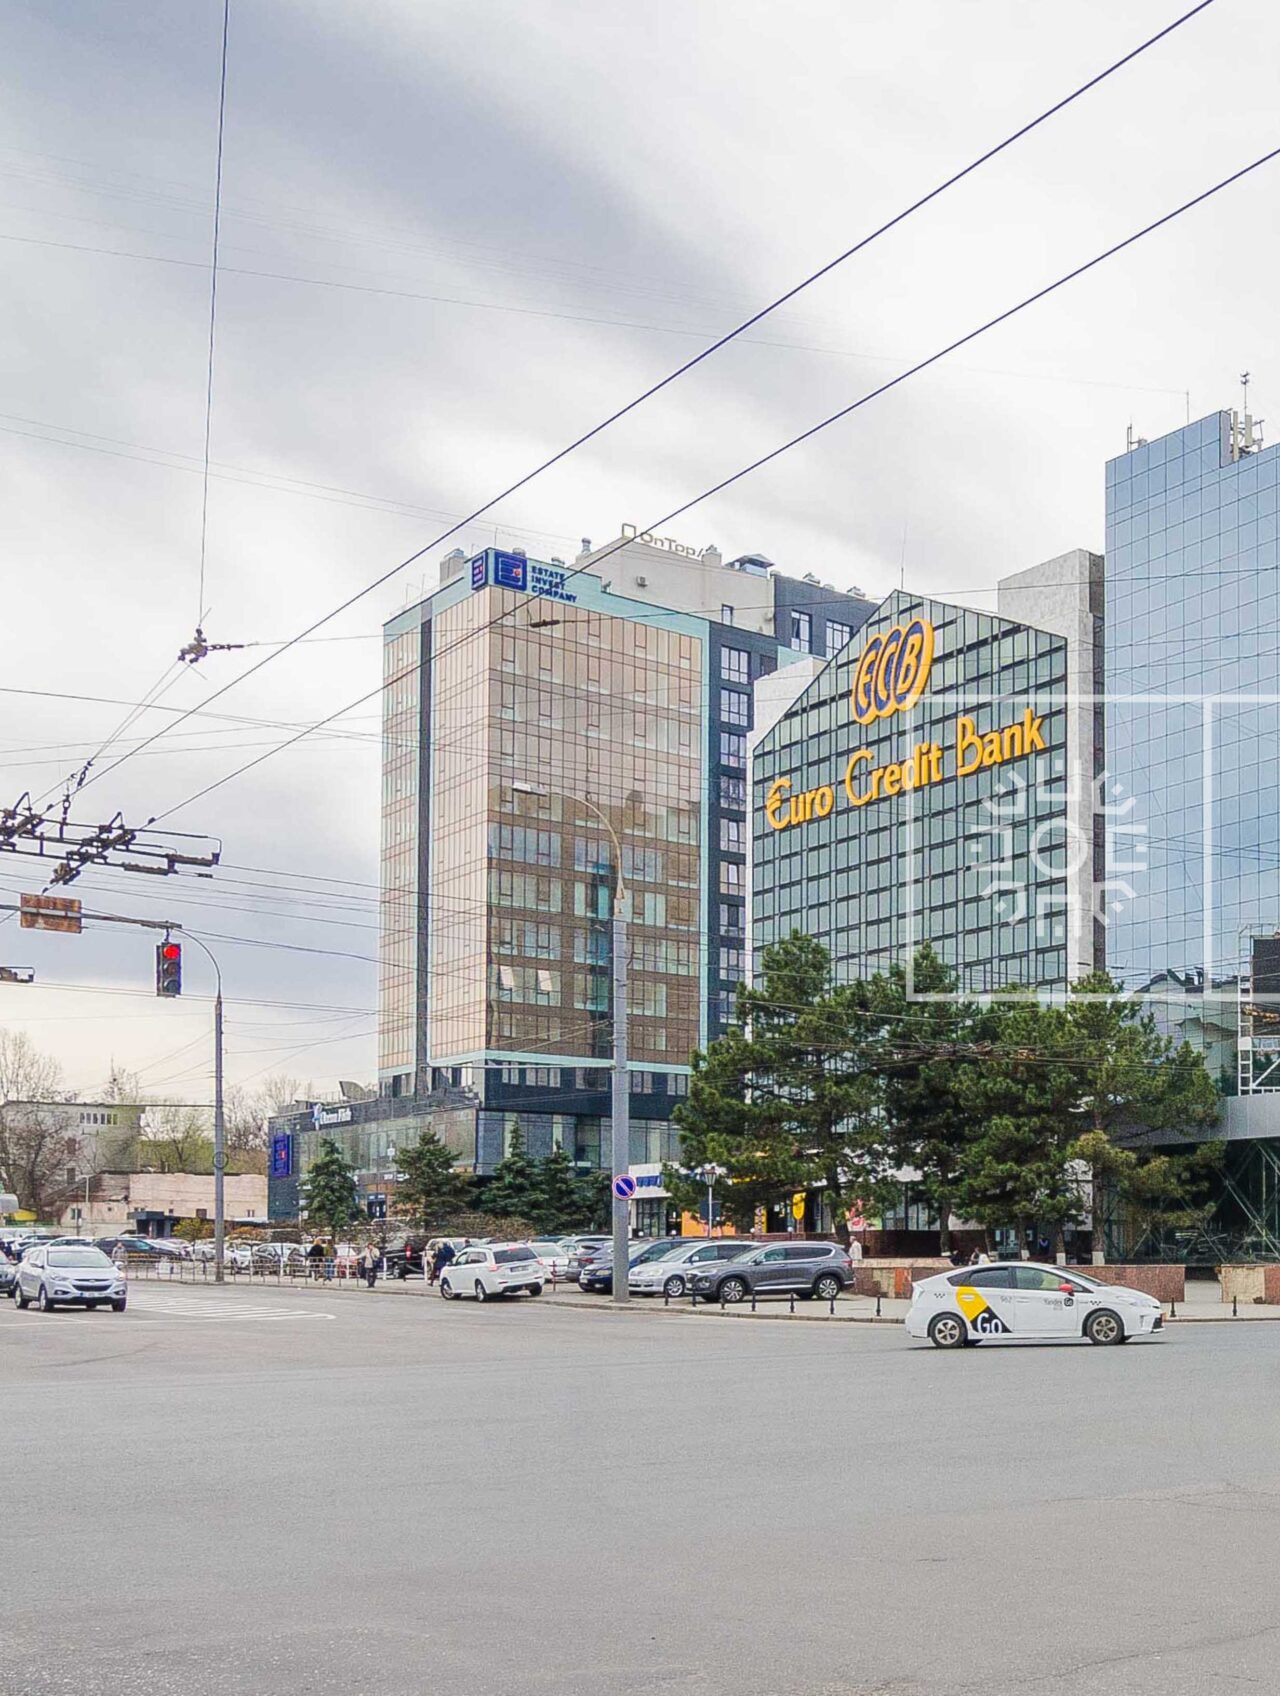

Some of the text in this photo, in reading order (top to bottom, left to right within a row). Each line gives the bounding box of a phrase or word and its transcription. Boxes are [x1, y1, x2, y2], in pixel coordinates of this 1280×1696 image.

[531, 565, 566, 581] ESTATE
[531, 575, 565, 591] INVEST
[531, 585, 577, 603] COMPANY
[845, 742, 942, 806] Credit
[957, 708, 1046, 777] Bank
[976, 1312, 1003, 1334] Go
